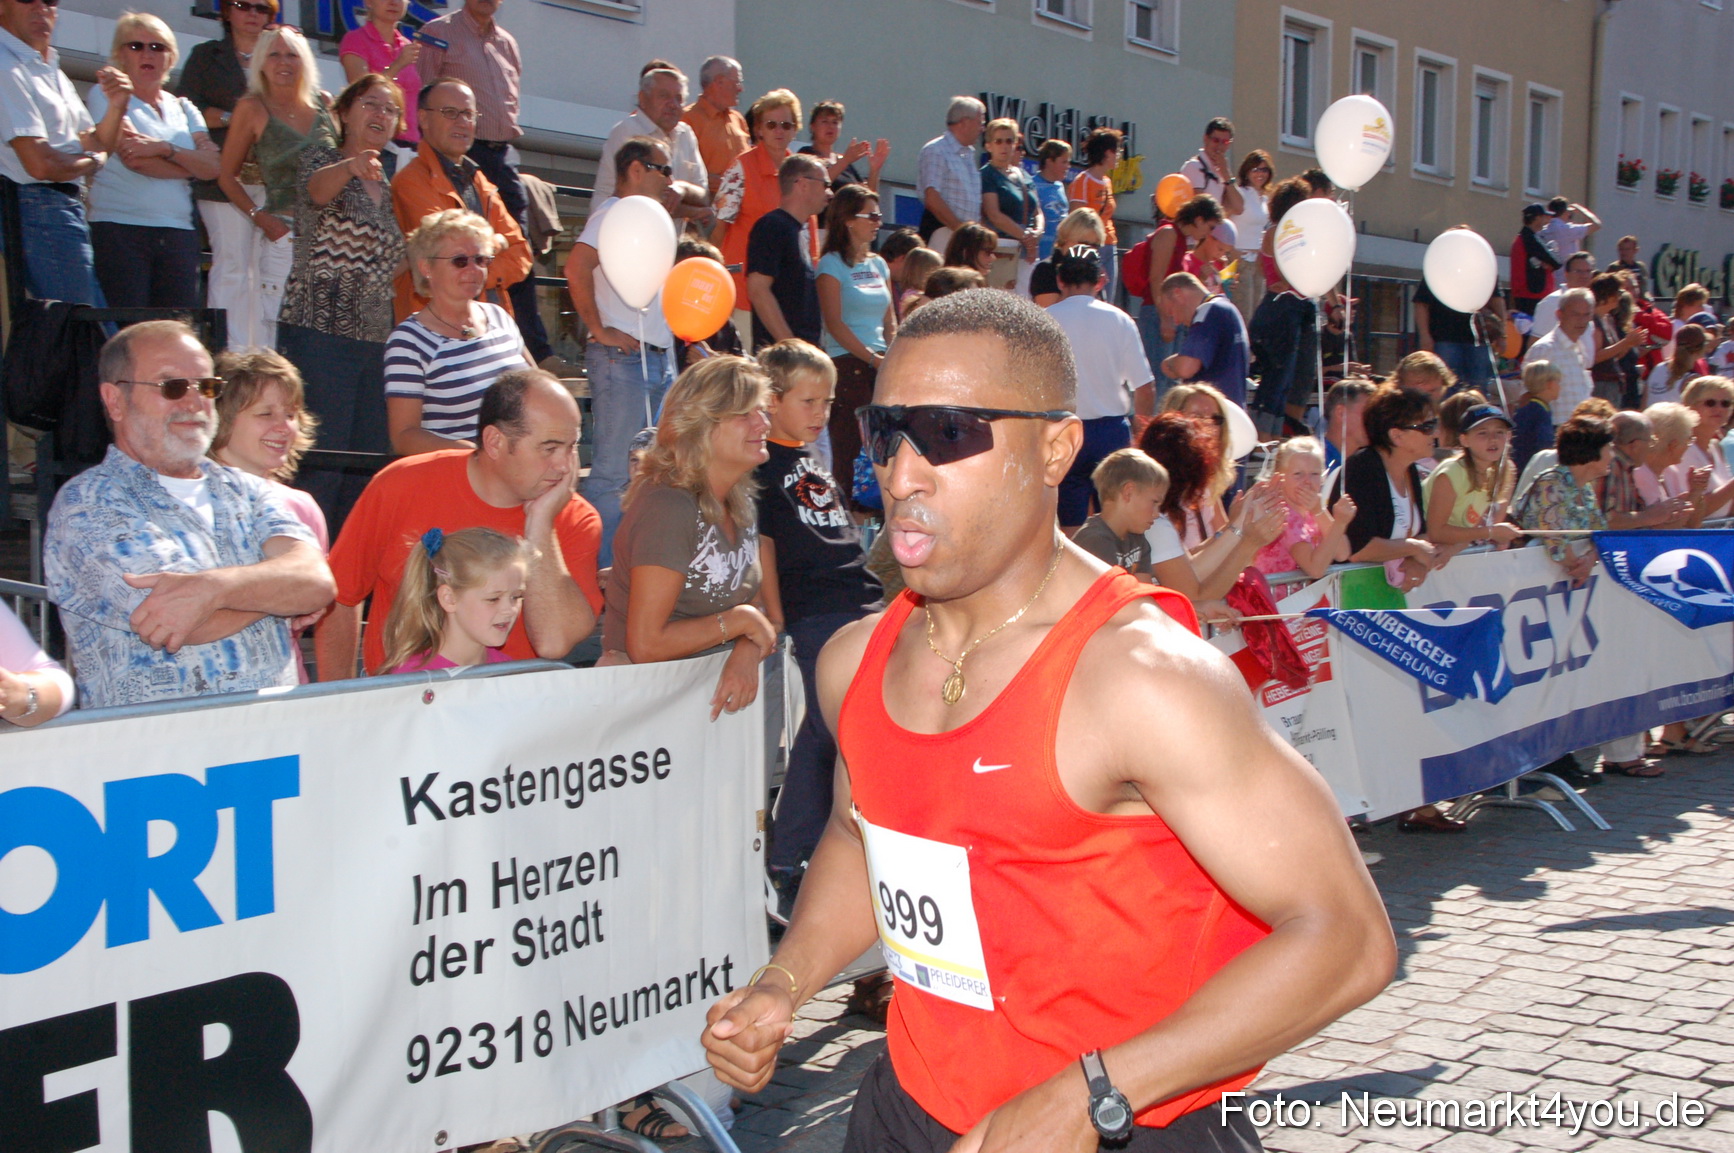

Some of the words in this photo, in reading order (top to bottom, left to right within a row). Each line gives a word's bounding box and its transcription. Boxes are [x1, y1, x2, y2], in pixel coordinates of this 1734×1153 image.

[1360, 610, 1458, 669] NBERGER
[1420, 572, 1599, 714] CK
[401, 747, 671, 826] Kastengasse
[0, 755, 300, 974] ORT
[412, 874, 467, 926] Im
[492, 846, 619, 909] Herzen
[410, 934, 495, 986] der
[512, 900, 604, 967] Stadt
[879, 881, 943, 946] 999
[407, 1009, 553, 1084] 92318
[564, 954, 734, 1047] Neumarkt
[930, 968, 989, 998] PFLEIDERER
